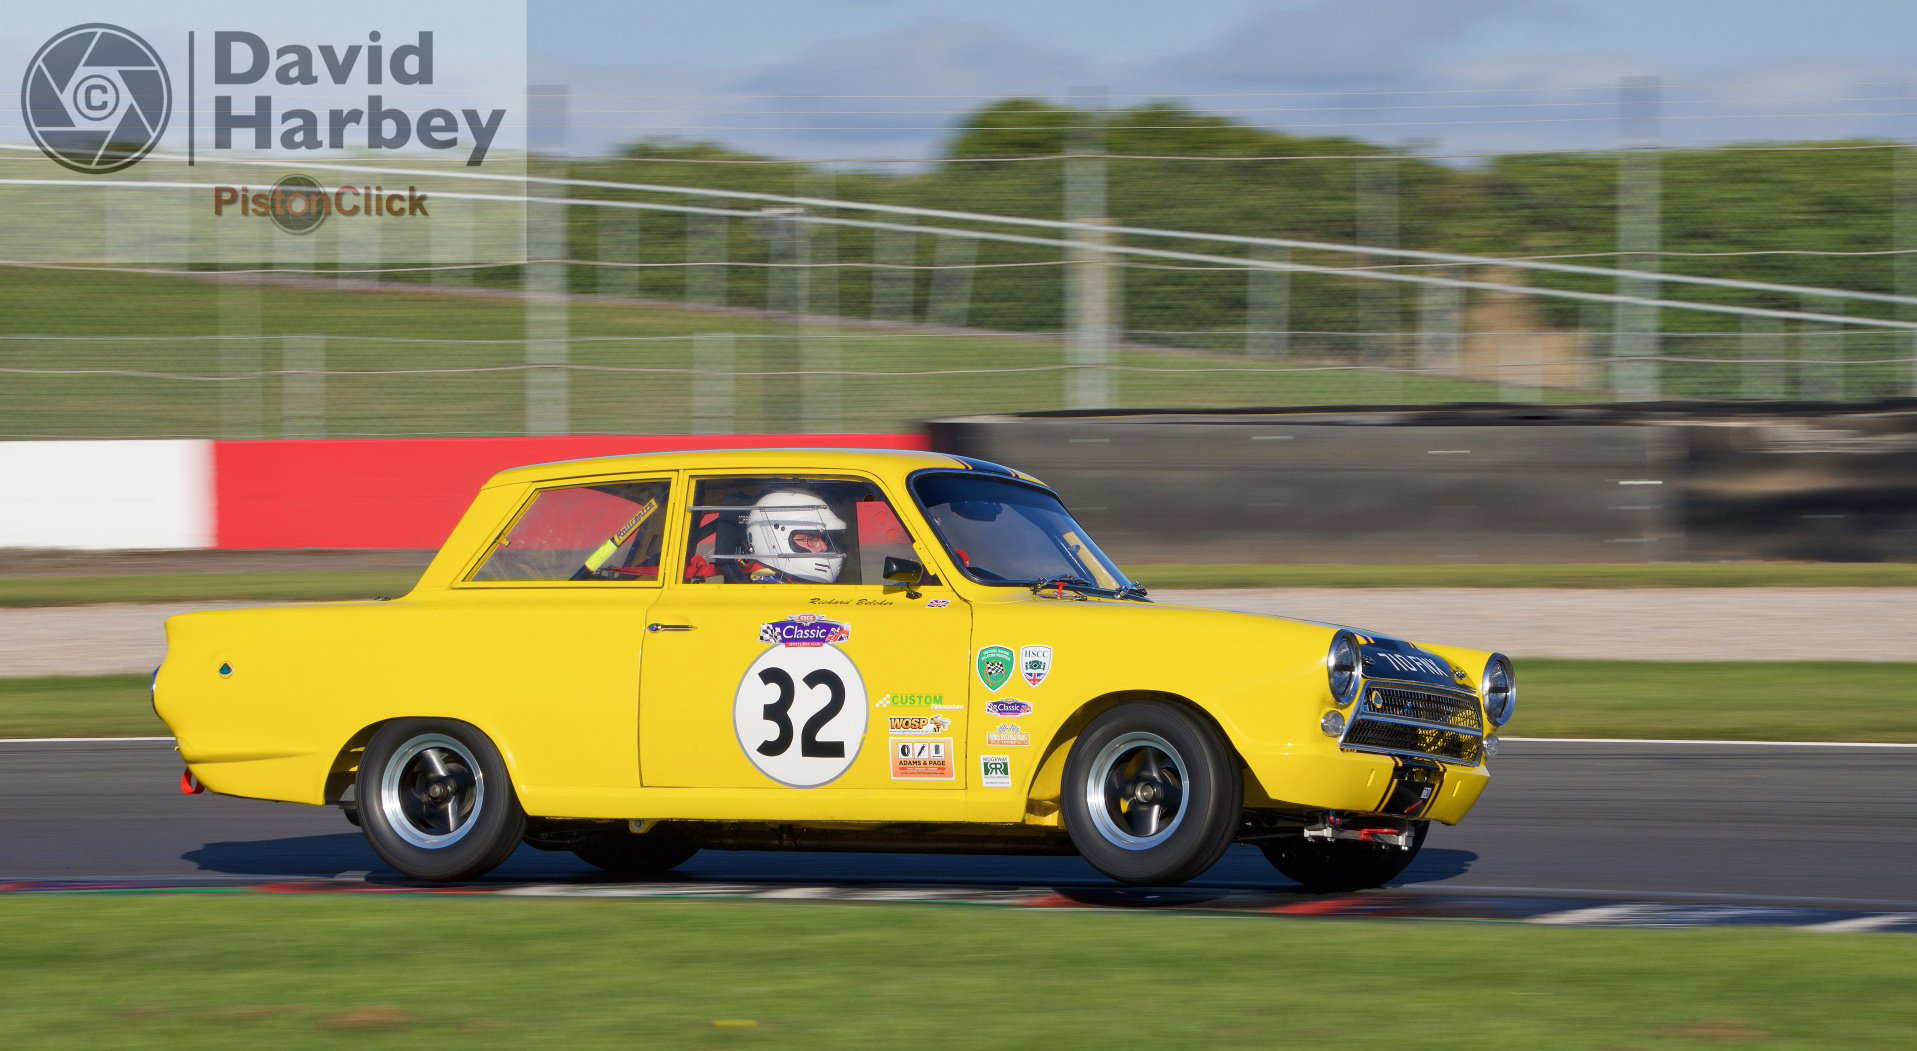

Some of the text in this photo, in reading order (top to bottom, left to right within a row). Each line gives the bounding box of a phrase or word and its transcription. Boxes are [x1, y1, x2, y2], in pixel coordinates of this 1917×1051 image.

[808, 597, 895, 606] Richard Belcher
[782, 625, 827, 639] Classic
[1024, 650, 1049, 658] HSCC
[1377, 653, 1417, 671] 710
[891, 695, 943, 705] CUSTOM
[756, 667, 845, 757] 32
[997, 703, 1020, 711] Classic
[889, 717, 929, 730] WOSP
